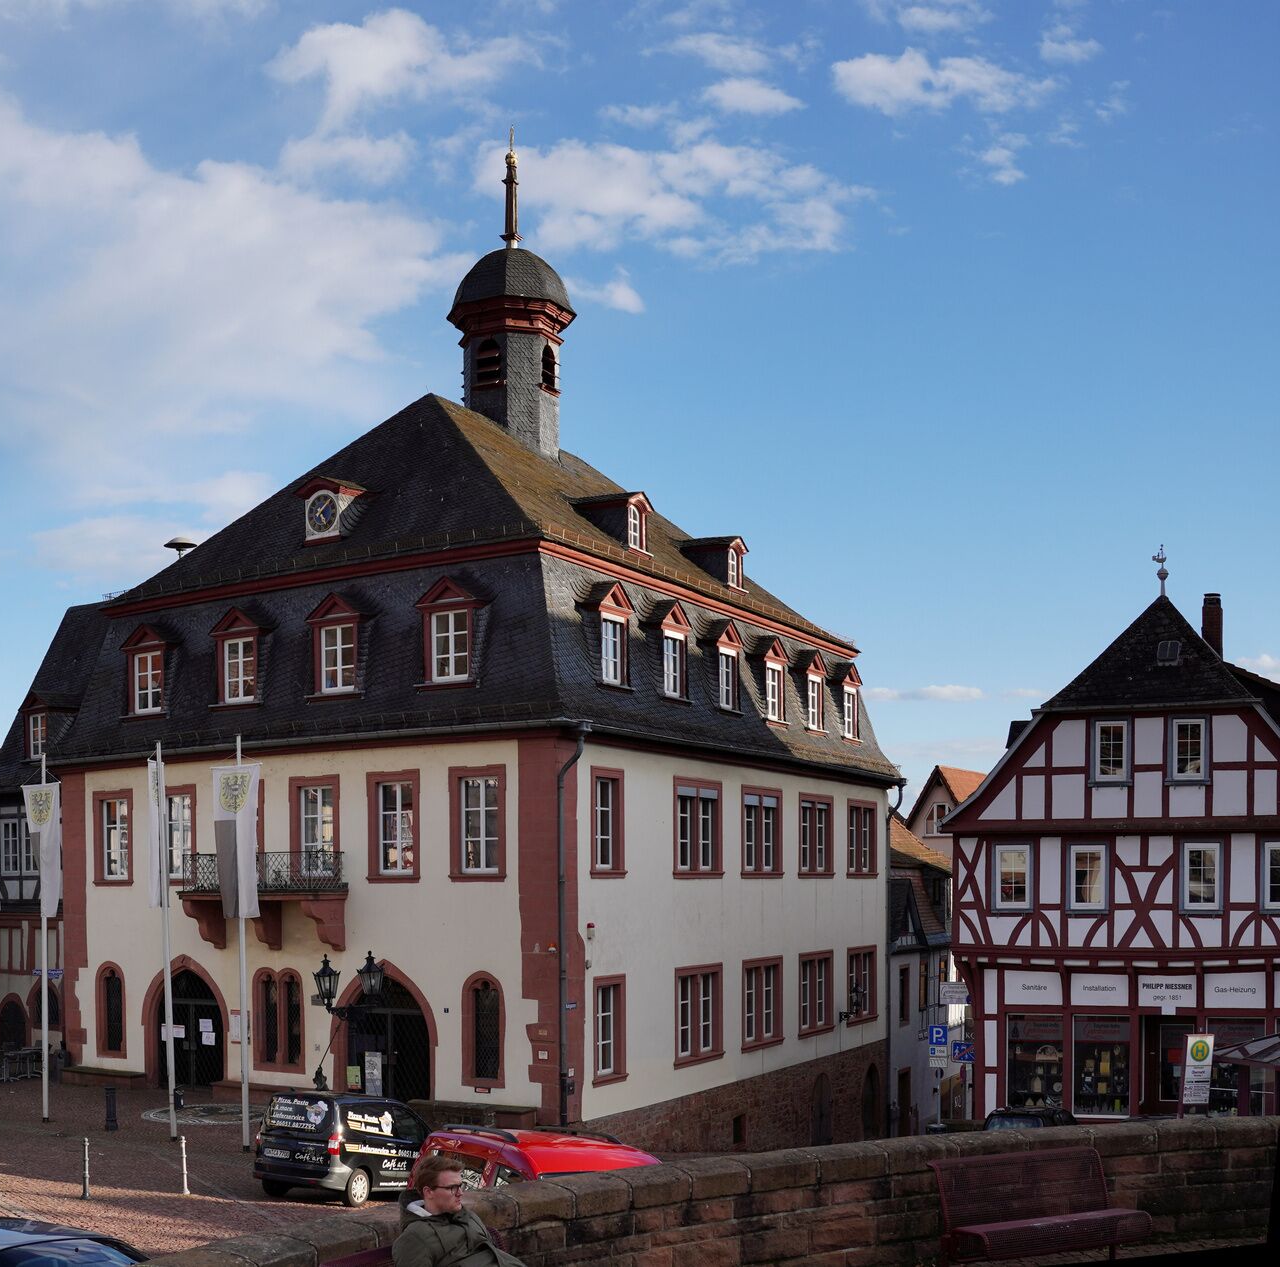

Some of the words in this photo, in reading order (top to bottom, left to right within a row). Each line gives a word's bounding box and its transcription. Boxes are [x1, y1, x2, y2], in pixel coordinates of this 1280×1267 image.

[1021, 983, 1048, 991] Sanitäre
[1214, 986, 1256, 994] Gas-Heizung
[932, 1027, 944, 1043] P
[272, 1112, 305, 1121] Lieferservice
[295, 1152, 311, 1161] Café
[382, 1158, 397, 1169] Café
[397, 1160, 407, 1168] art
